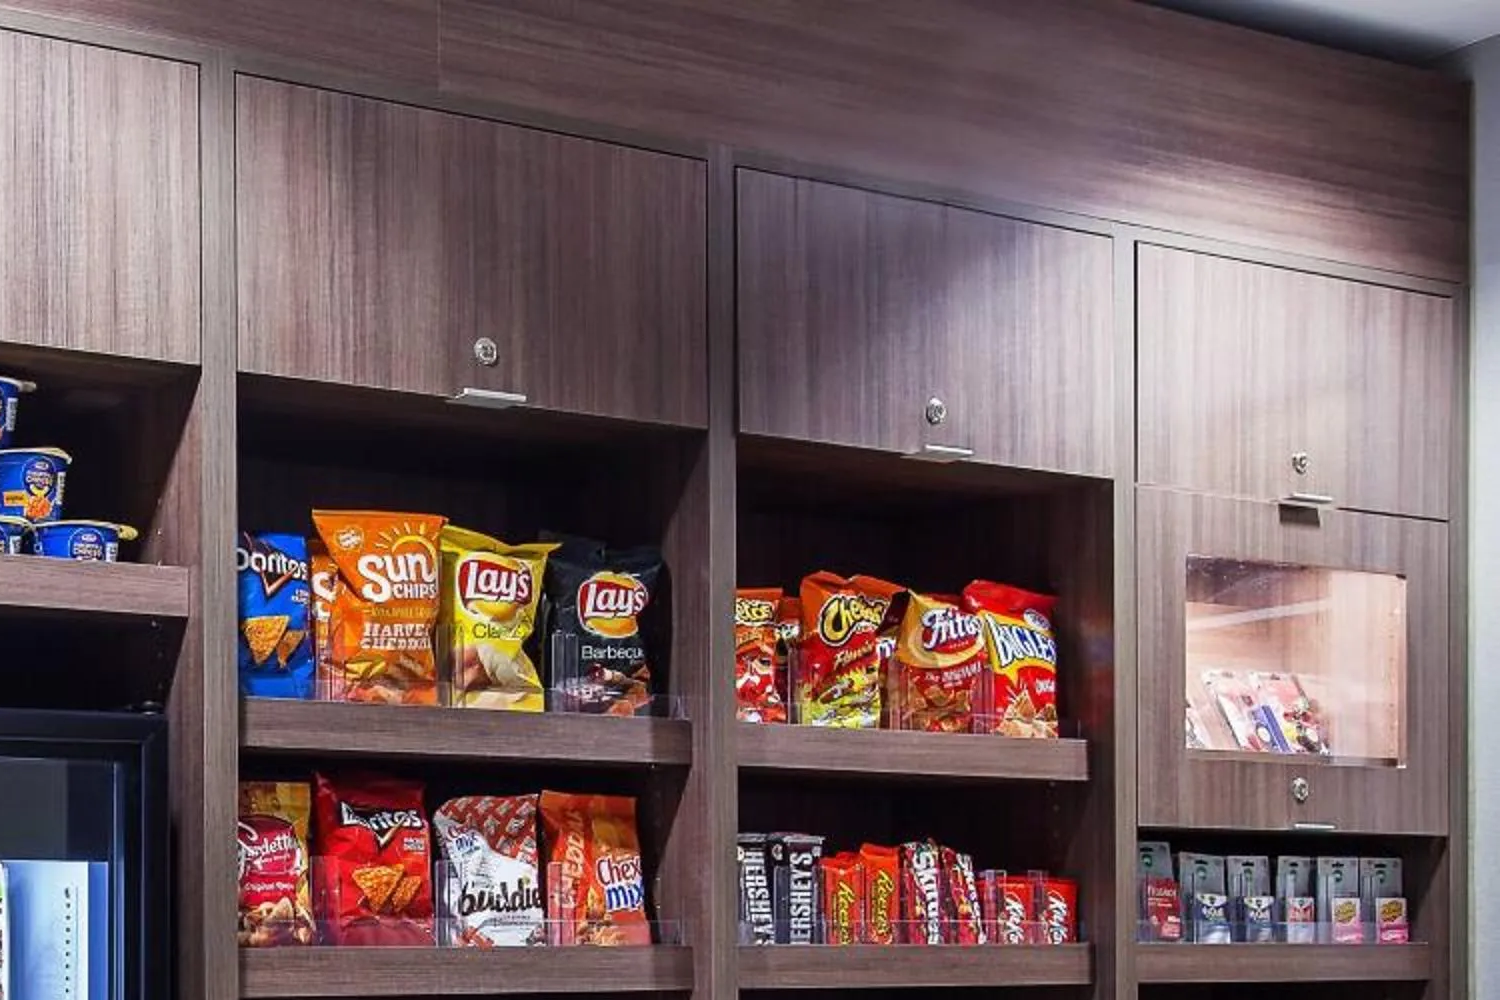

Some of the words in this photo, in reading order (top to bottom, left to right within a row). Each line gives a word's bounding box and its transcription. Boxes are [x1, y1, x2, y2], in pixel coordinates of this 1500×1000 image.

[236, 547, 308, 579] Doritos
[358, 552, 436, 604] Sun
[393, 583, 437, 600] CHIPS
[465, 559, 531, 602] Lay's
[585, 583, 646, 618] Lay's
[360, 637, 432, 650] CHEDDA
[363, 622, 431, 637] HARVE
[922, 608, 982, 649] Fritos
[341, 801, 422, 831] Dritos
[597, 855, 641, 886] Chex
[606, 885, 645, 911] mix
[790, 851, 813, 945] ERSHEY'S
